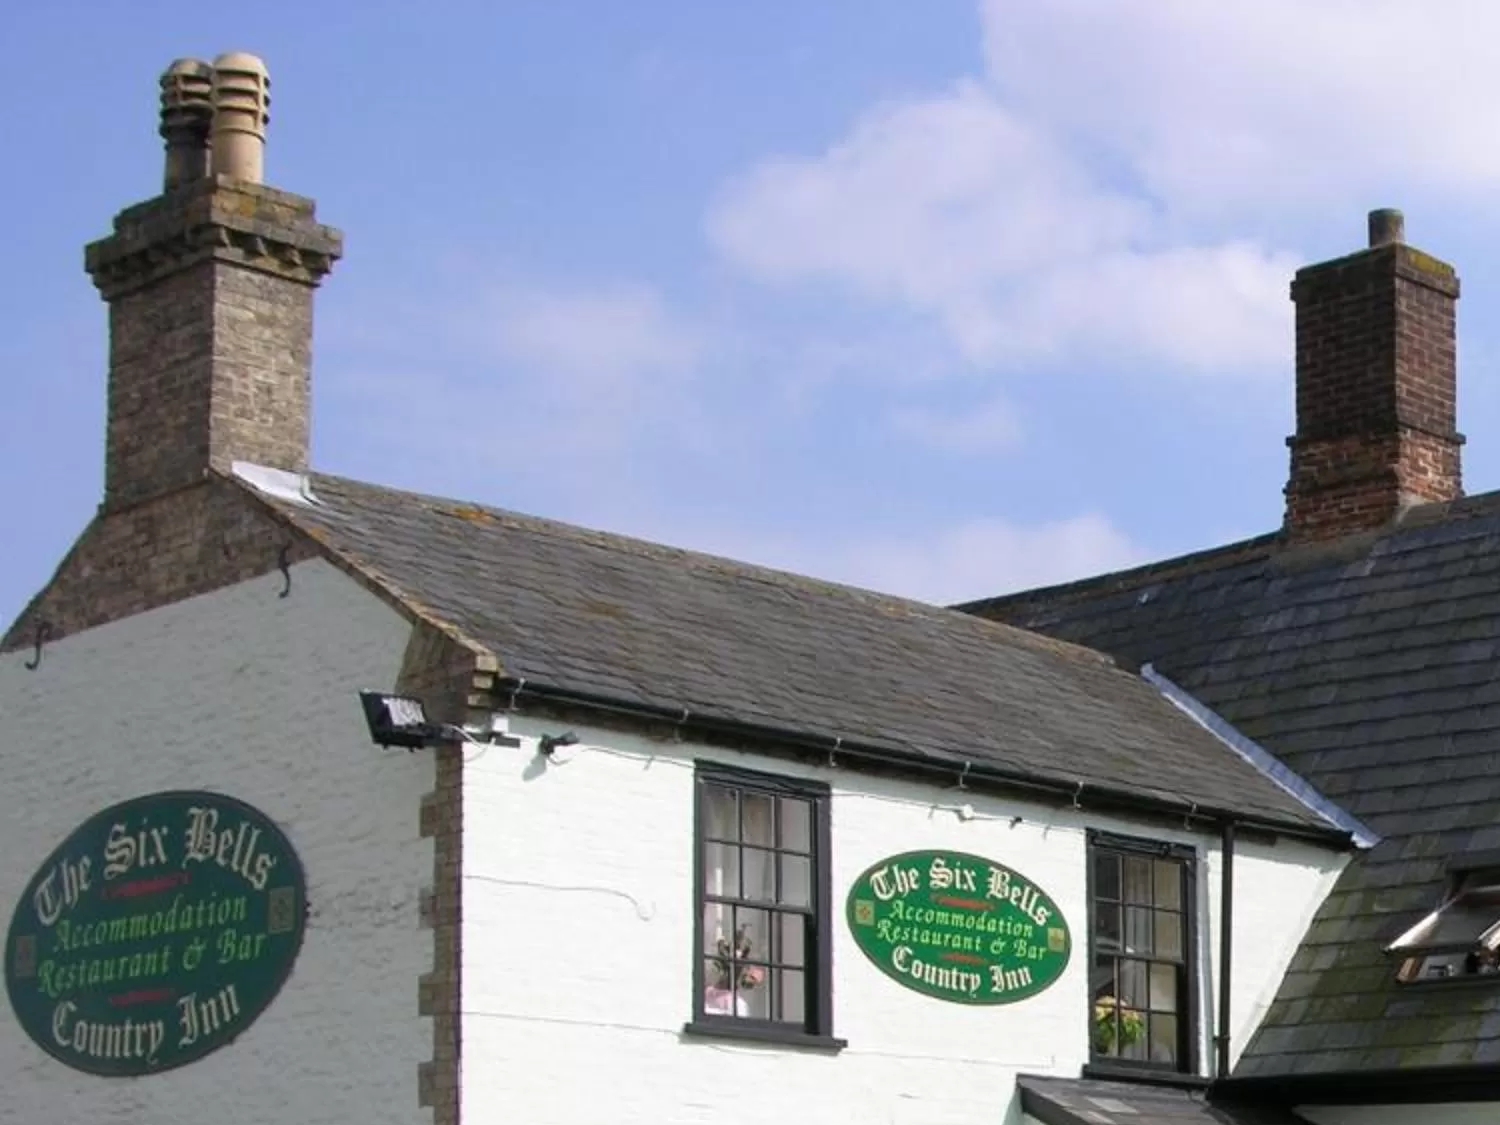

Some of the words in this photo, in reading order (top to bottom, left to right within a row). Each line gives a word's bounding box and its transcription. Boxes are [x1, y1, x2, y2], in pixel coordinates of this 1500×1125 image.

[35, 854, 93, 927] The
[103, 817, 169, 881] Six
[182, 806, 277, 890] Bells
[870, 864, 919, 900] The
[929, 857, 976, 891] Six
[986, 867, 1051, 925] Bells
[54, 893, 248, 952] Accommodation
[876, 919, 981, 950] Restaurant
[989, 937, 1005, 955] &
[1013, 938, 1047, 961] Bar
[890, 900, 1033, 938] Accommodation
[38, 946, 171, 997] Restaurant
[182, 936, 206, 971] &
[217, 927, 267, 965] Bar
[892, 944, 981, 998] Country
[989, 963, 1033, 993] Inn
[52, 999, 164, 1066] Country
[176, 983, 241, 1049] Inn
